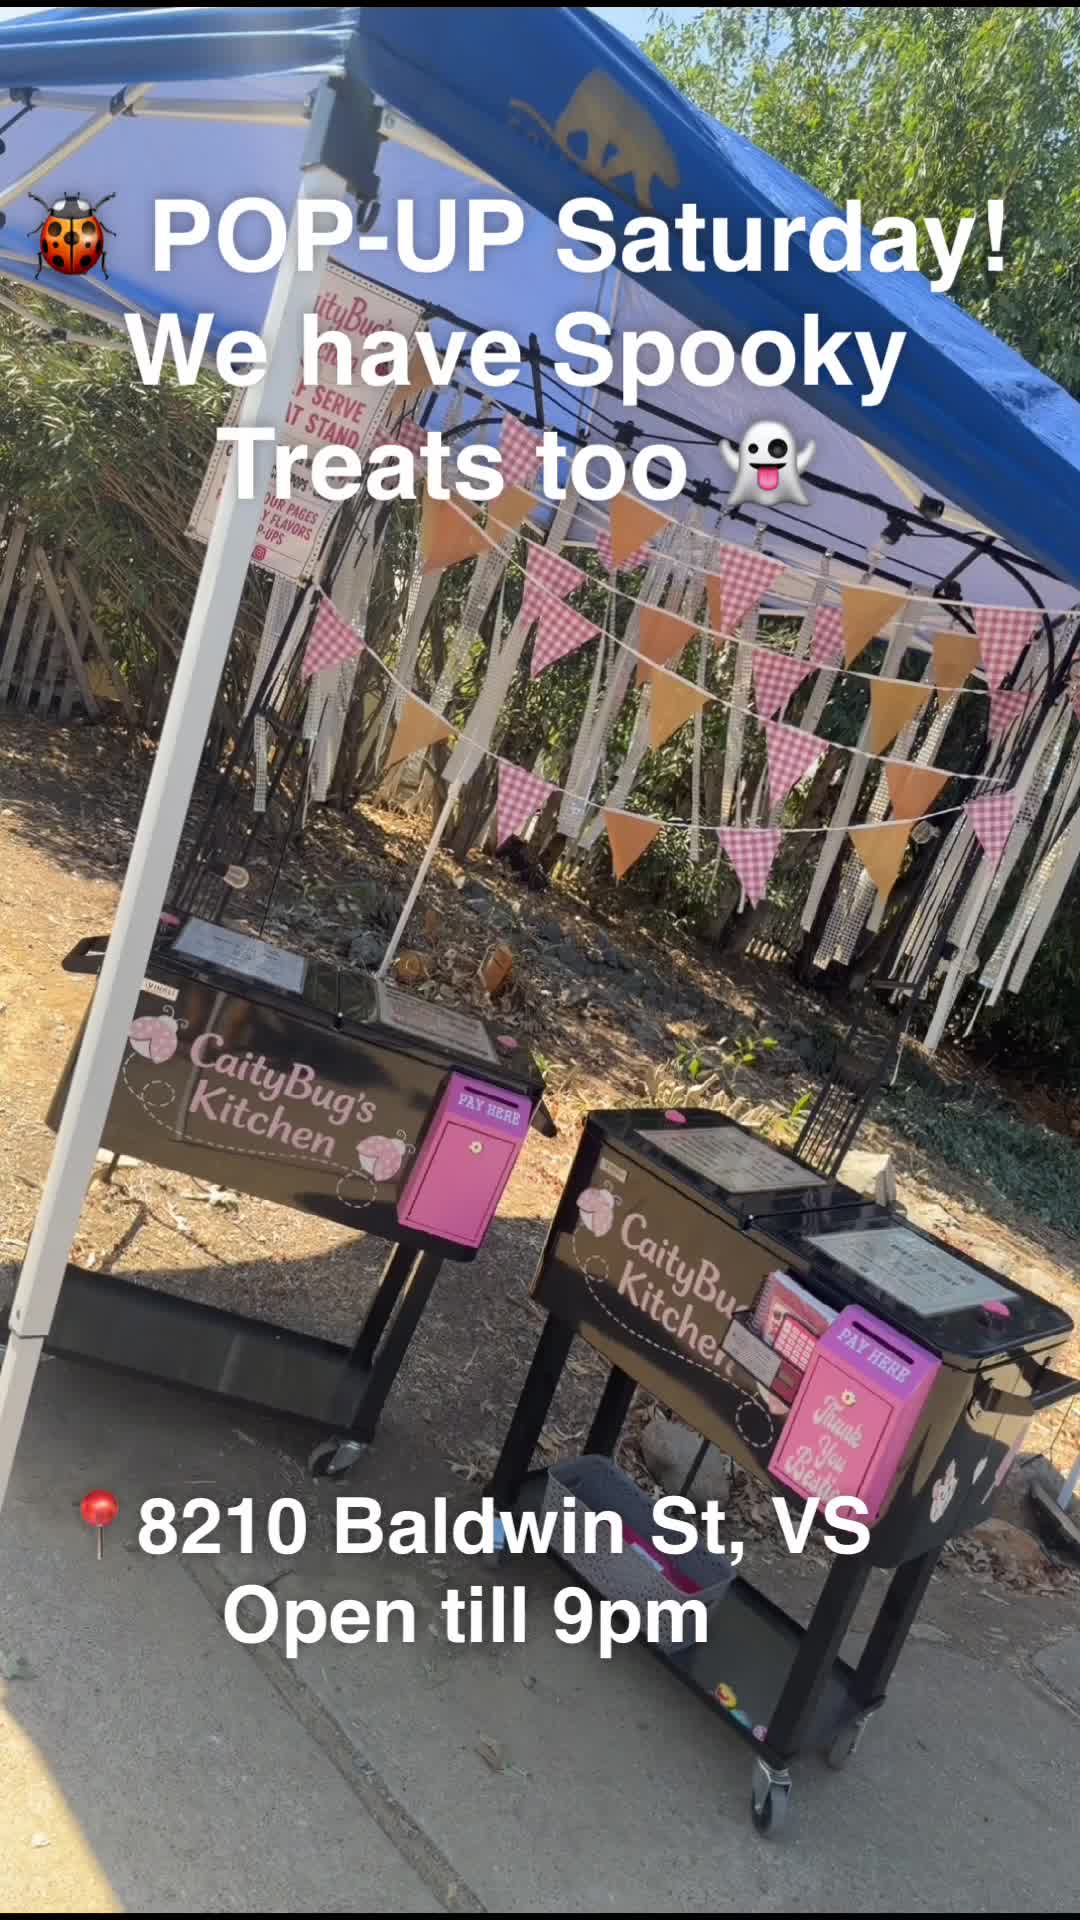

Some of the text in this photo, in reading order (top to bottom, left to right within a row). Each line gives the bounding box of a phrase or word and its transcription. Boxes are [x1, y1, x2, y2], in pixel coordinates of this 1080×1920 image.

[311, 383, 367, 424] SERVE
[304, 412, 360, 449] STAND
[270, 513, 313, 541] FLAVORS
[286, 501, 319, 525] PAGES
[190, 1032, 377, 1126] CaityBug's
[189, 1078, 336, 1159] Kitchen
[458, 1093, 521, 1127] PAY HERE
[621, 1212, 749, 1319] CaityBu
[836, 1327, 911, 1384] PAY HERE
[812, 1394, 864, 1449] Thank
[814, 1434, 848, 1474] You
